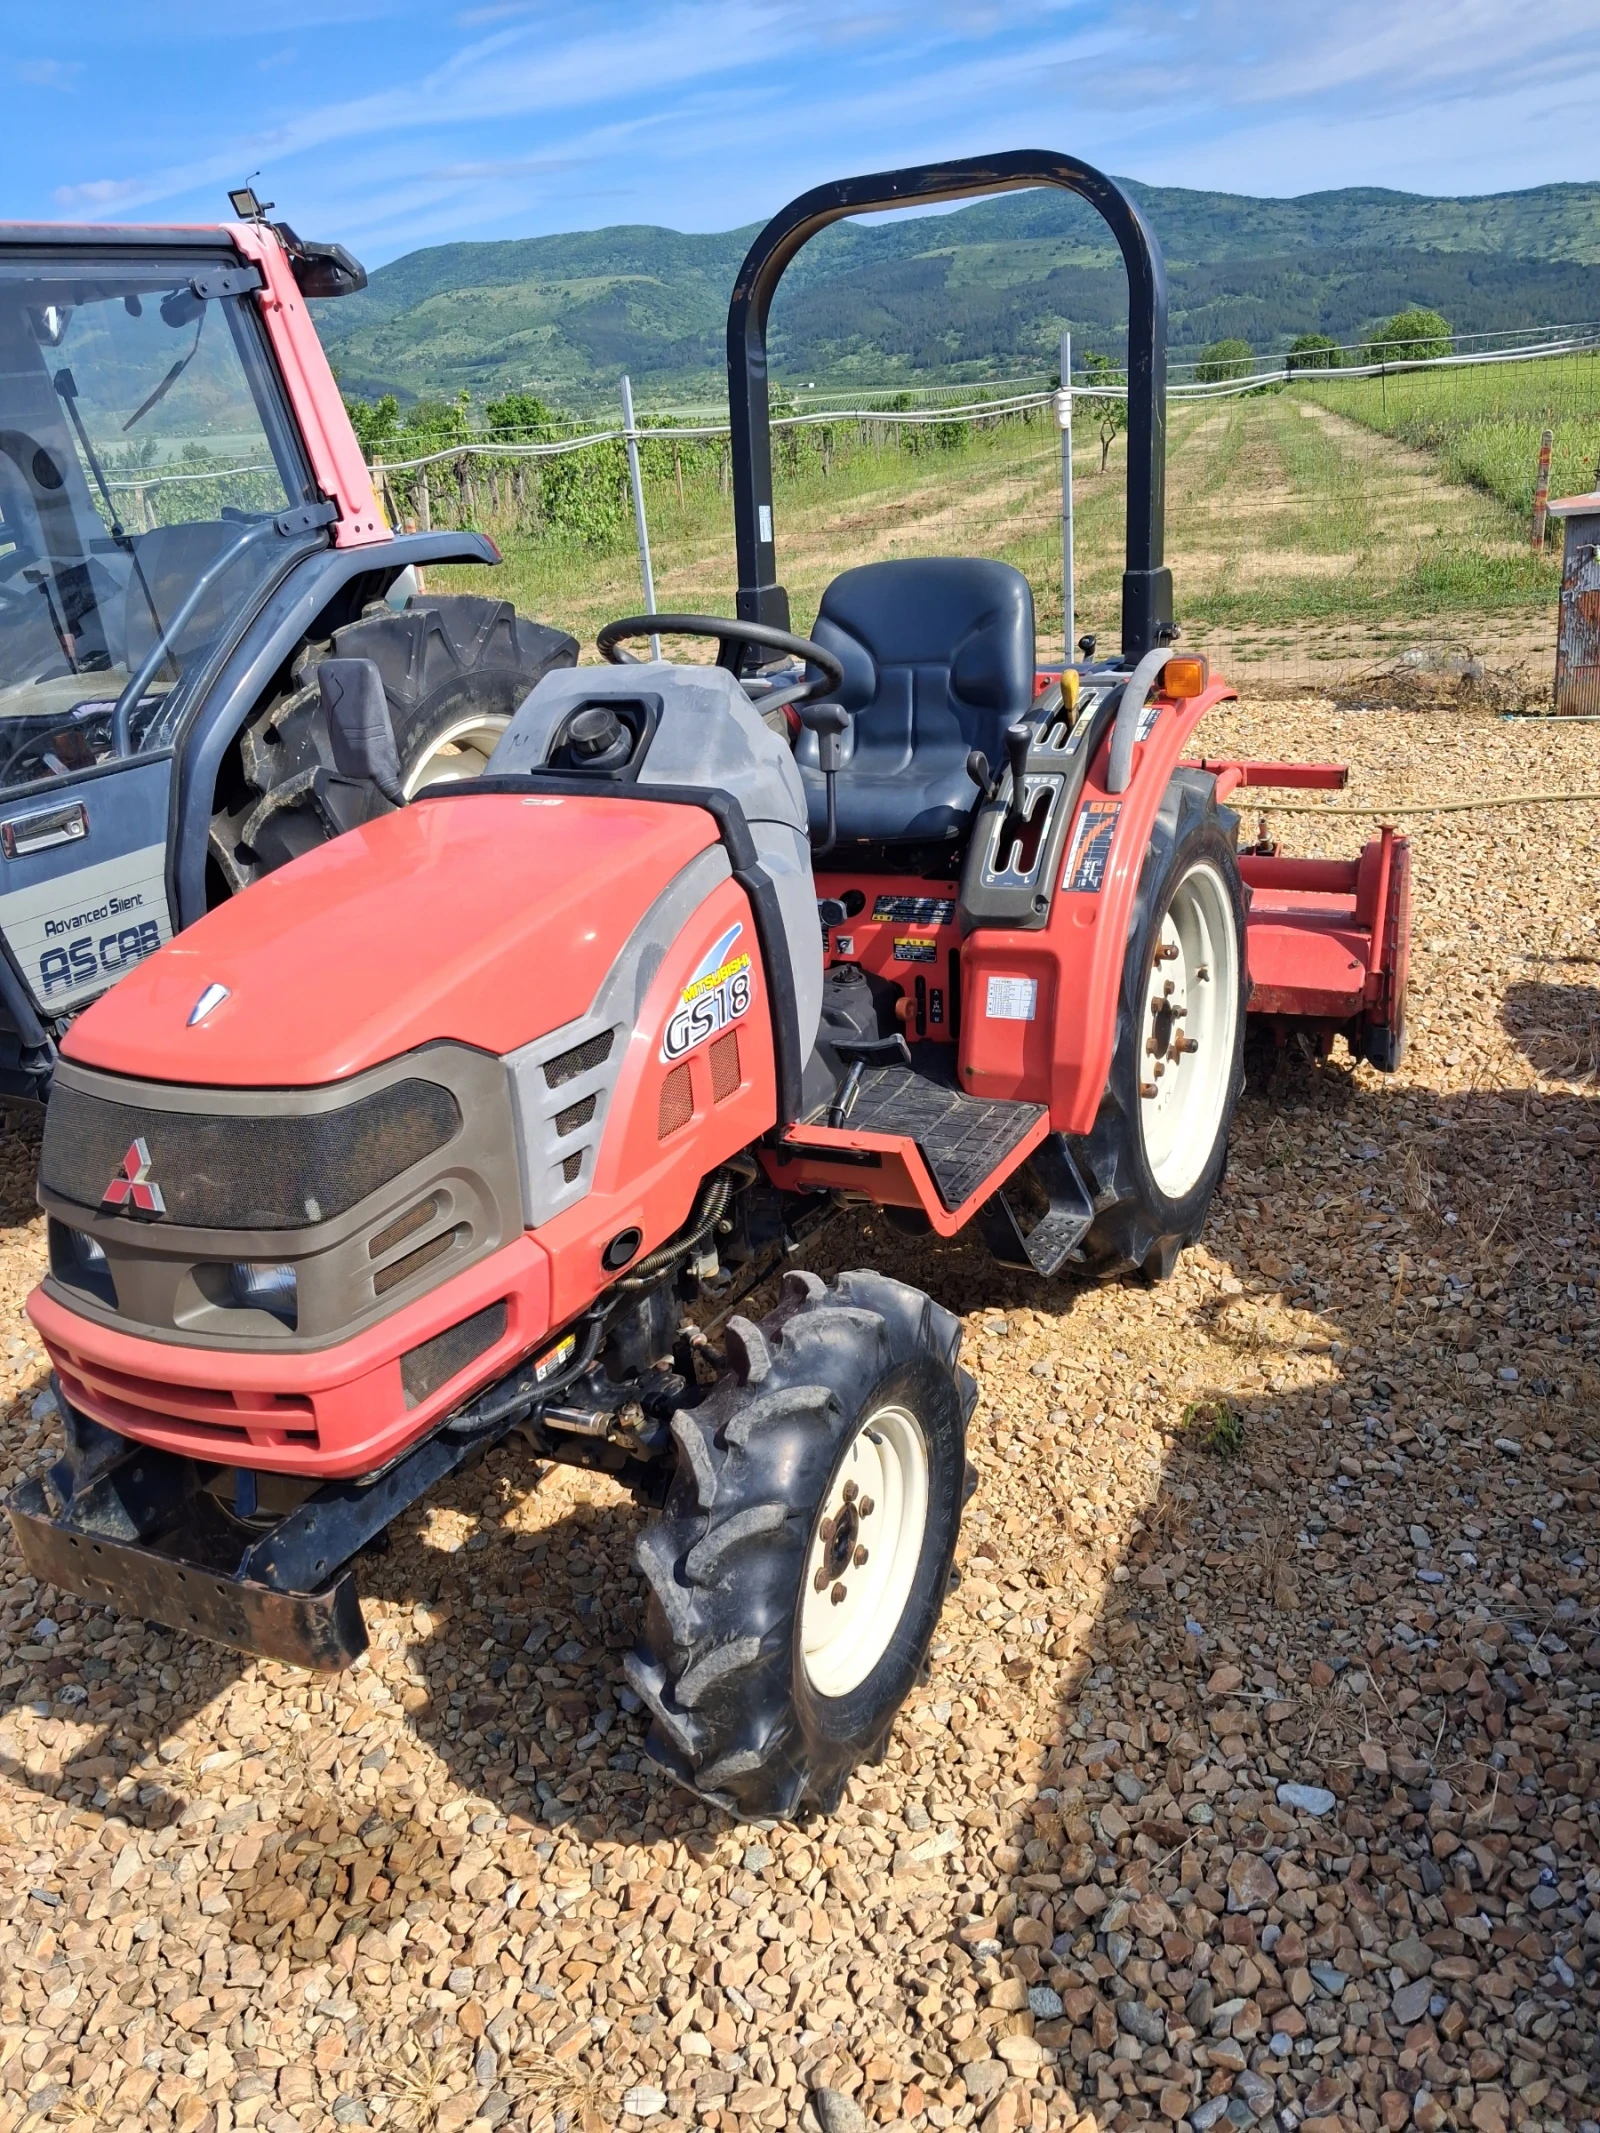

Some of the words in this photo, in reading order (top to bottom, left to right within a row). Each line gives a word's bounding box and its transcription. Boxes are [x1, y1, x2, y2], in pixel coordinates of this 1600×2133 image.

[986, 874, 996, 883] 3
[1024, 876, 1030, 884] 1
[44, 905, 108, 938] Advanced
[109, 893, 143, 915] Silent
[682, 952, 750, 1004] MITSUBISHI
[664, 973, 751, 1060] GS18
